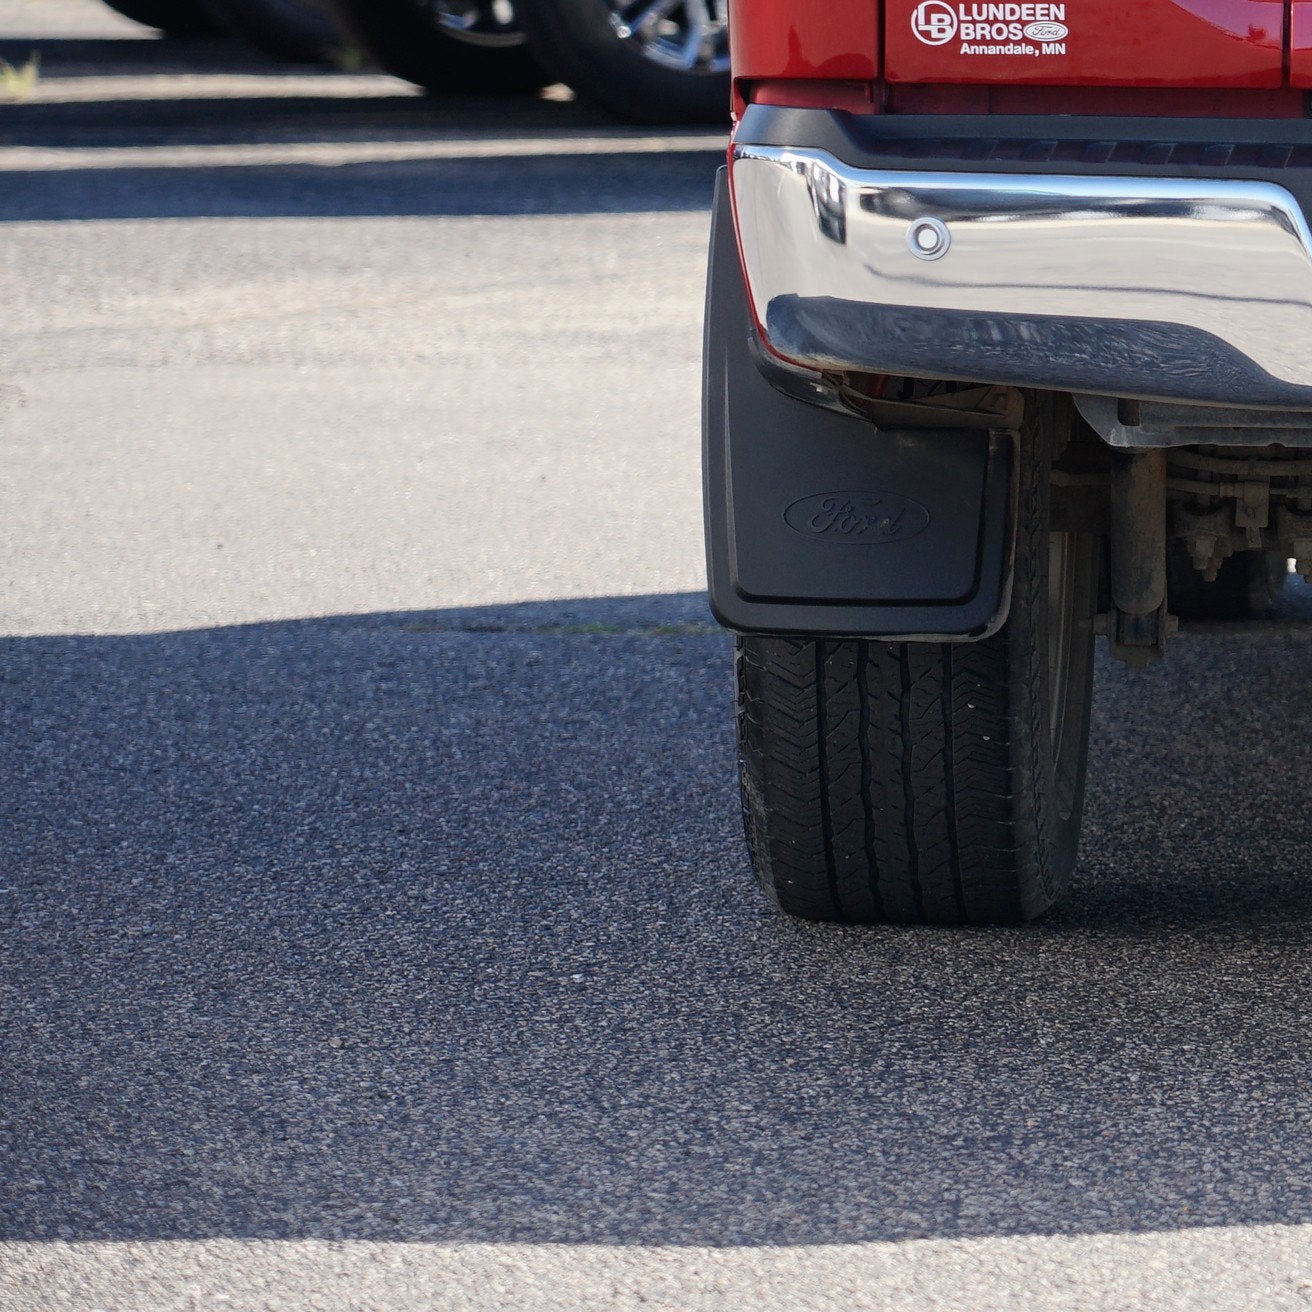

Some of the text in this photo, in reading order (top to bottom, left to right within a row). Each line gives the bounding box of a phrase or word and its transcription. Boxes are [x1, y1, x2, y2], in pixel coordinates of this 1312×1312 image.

[958, 3, 1066, 21] LUNDEEN
[959, 22, 1062, 41] BROS Ford
[959, 42, 1067, 57] Annandale, MN
[810, 497, 907, 537] Ford
